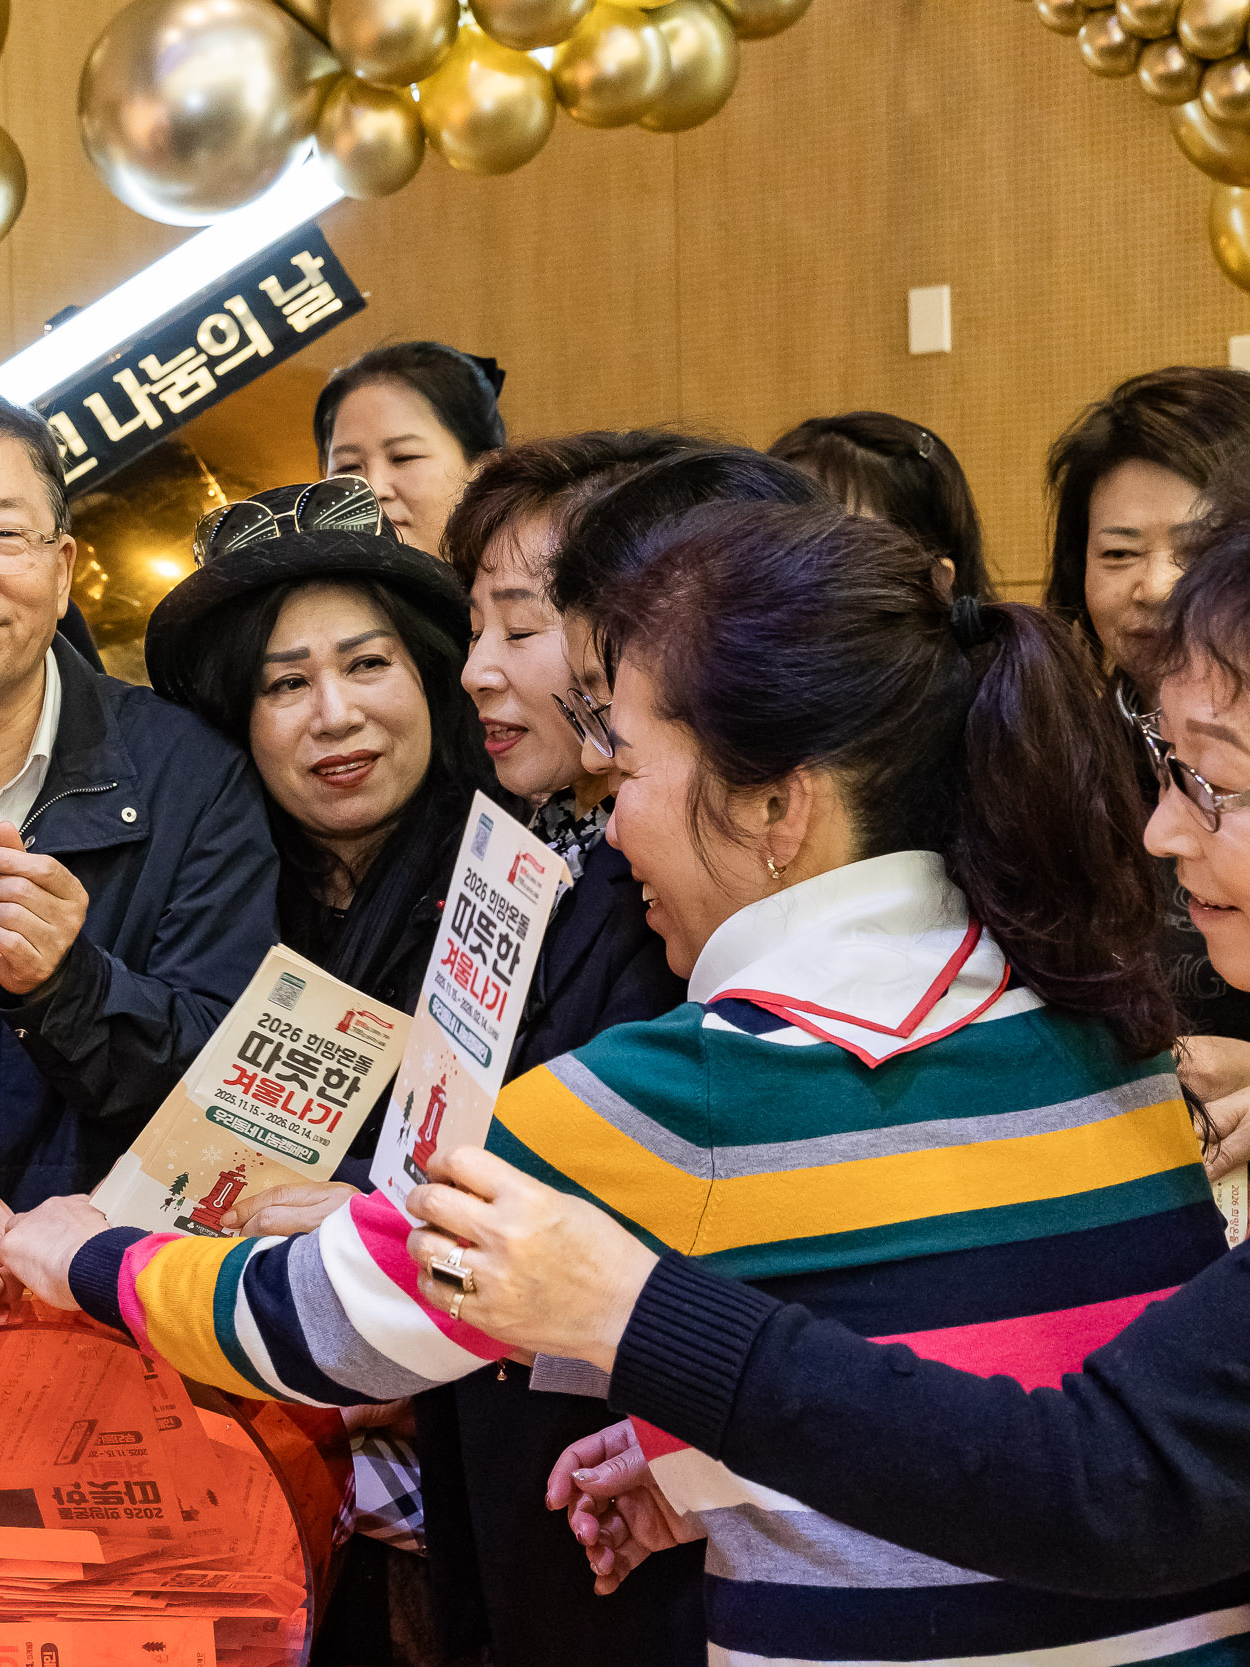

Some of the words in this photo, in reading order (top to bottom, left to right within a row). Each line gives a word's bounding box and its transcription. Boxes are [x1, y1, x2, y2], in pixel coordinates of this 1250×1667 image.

[83, 295, 274, 442] 나눔의
[258, 250, 342, 333] 날
[451, 891, 520, 987] 따뜻한
[463, 867, 488, 902] 2026
[487, 888, 530, 941] 희망온돌
[441, 938, 508, 1022] 겨울나기
[237, 1030, 361, 1108] 따뜻한
[257, 1012, 303, 1043] 2026
[303, 1034, 375, 1076] 희망온돌
[212, 1108, 258, 1138] 우리동네
[259, 1129, 315, 1162] 나눔캠페인
[223, 1063, 343, 1133] 겨울나기
[124, 1507, 164, 1520] 2026
